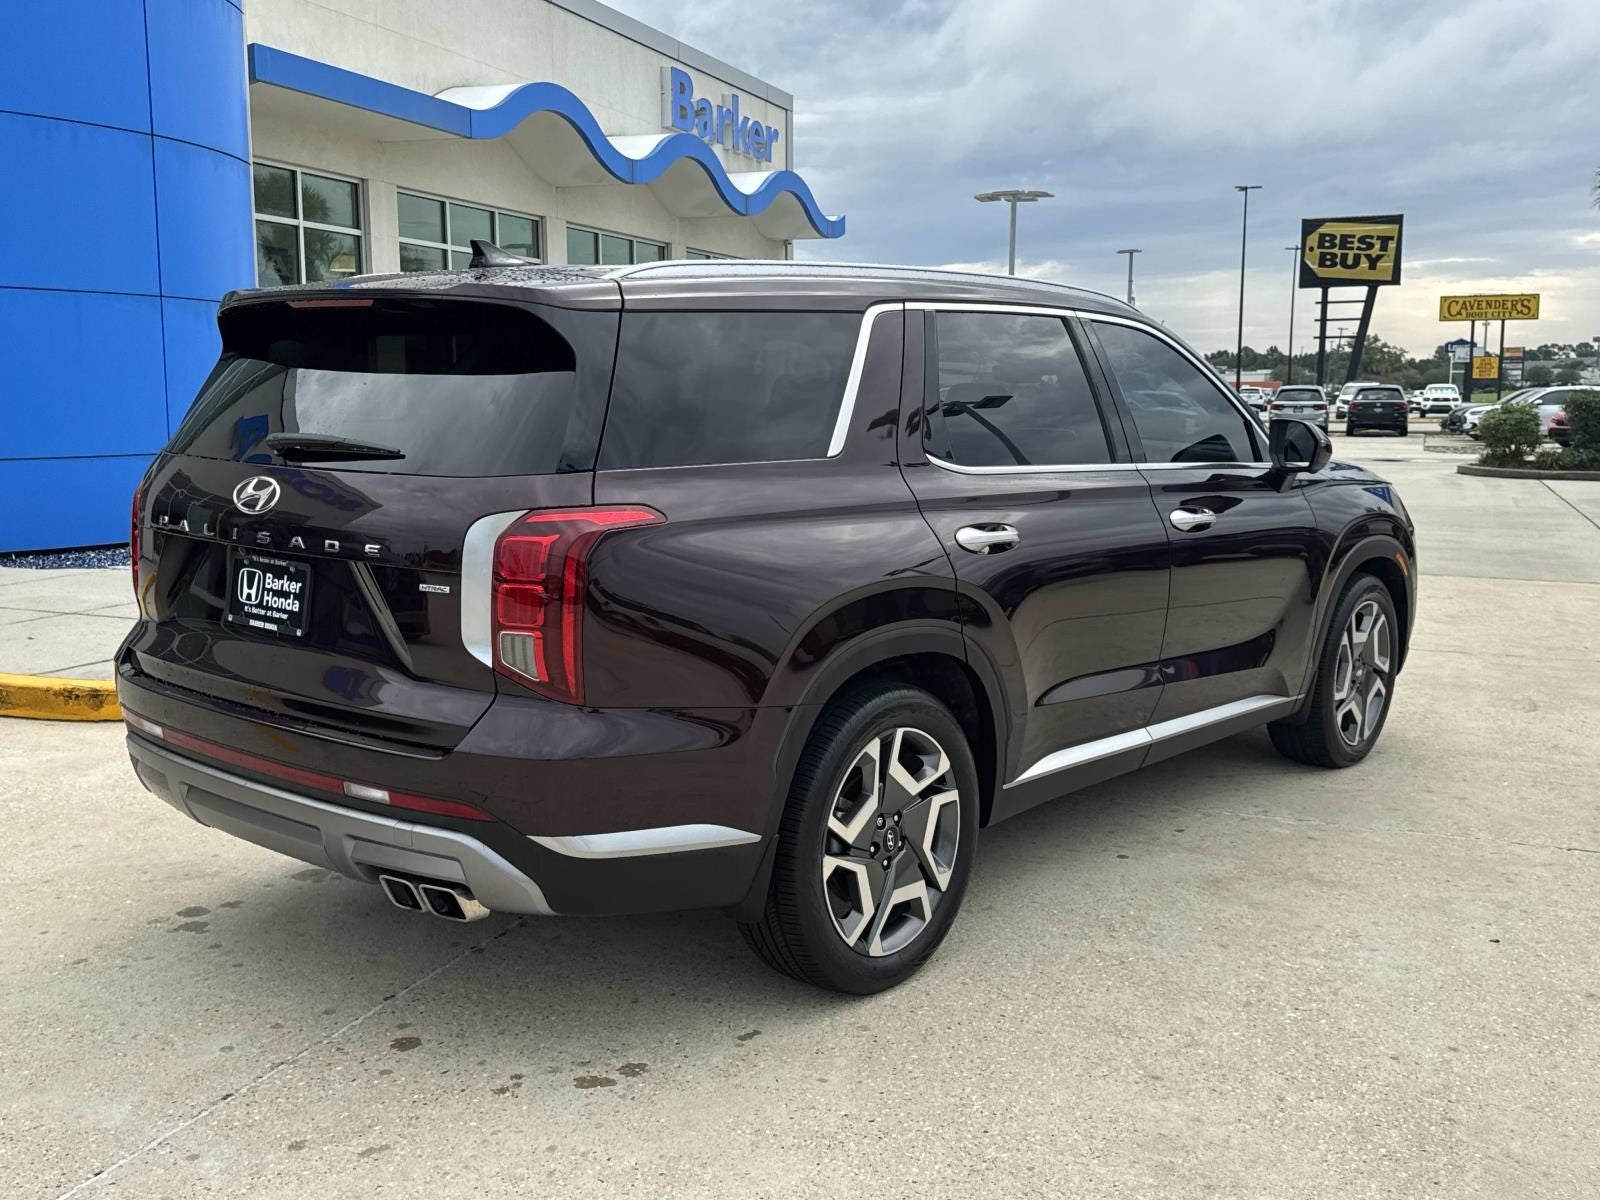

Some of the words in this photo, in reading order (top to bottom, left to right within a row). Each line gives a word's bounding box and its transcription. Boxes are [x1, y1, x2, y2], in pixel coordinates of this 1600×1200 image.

[670, 66, 780, 163] Barker
[1317, 233, 1395, 253] BEST
[1317, 251, 1387, 271] BUY
[1447, 297, 1533, 317] CAVENDER'S
[1491, 310, 1514, 318] CITY
[158, 515, 382, 558] PALISADE
[265, 573, 302, 594] Barker
[263, 591, 300, 612] Honda
